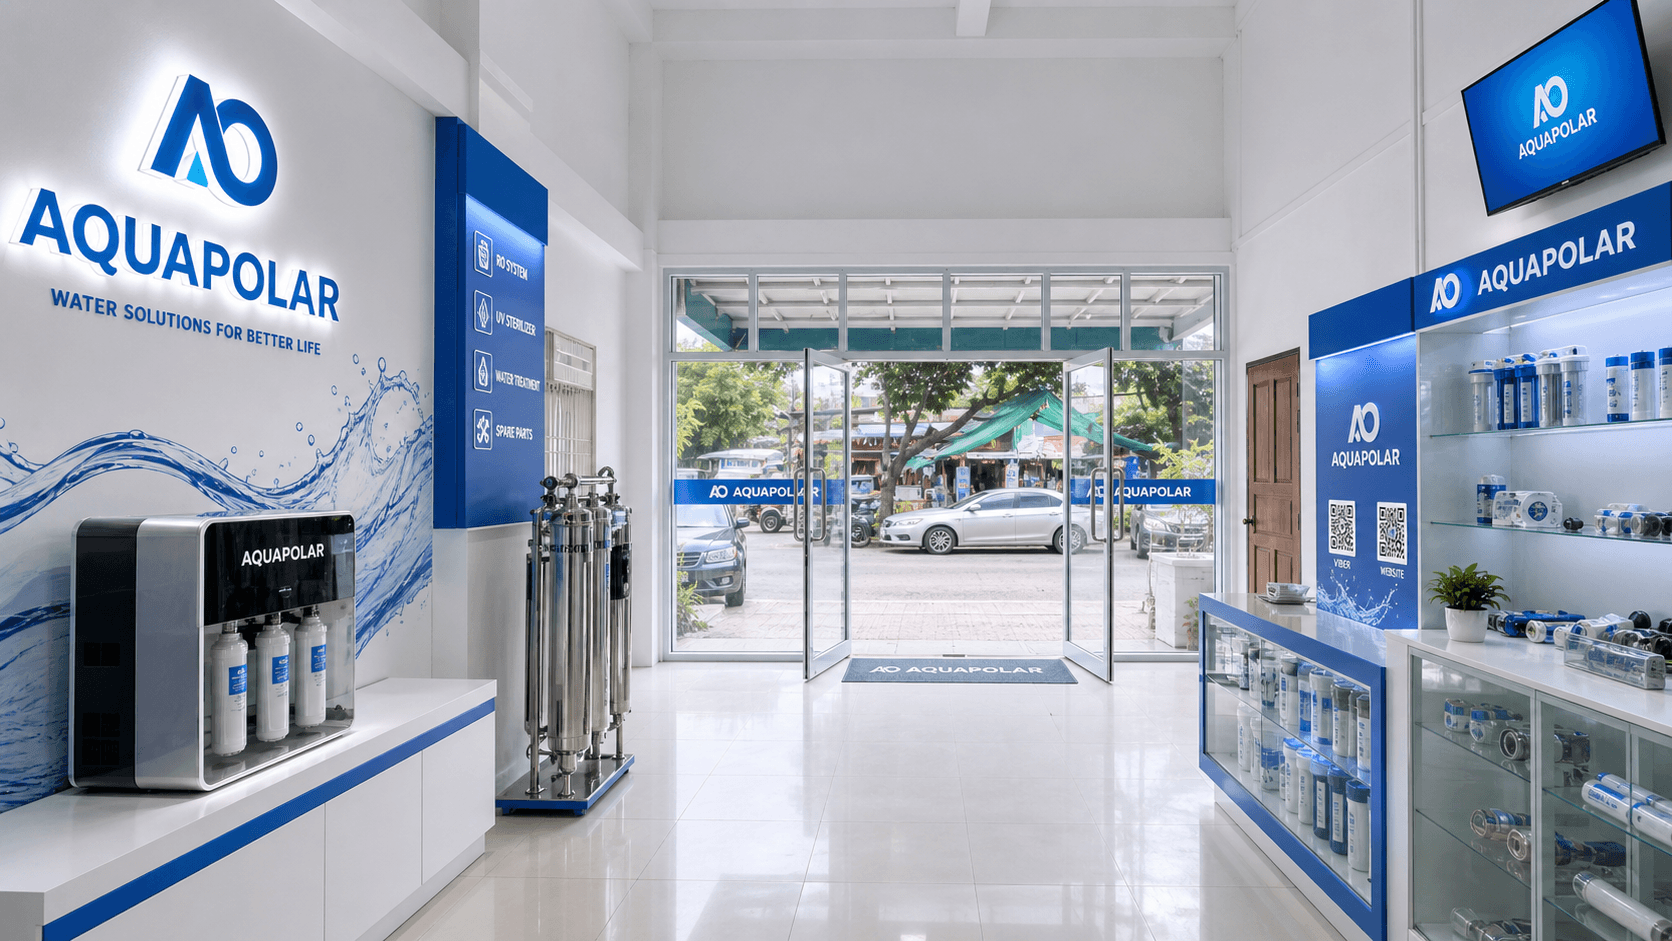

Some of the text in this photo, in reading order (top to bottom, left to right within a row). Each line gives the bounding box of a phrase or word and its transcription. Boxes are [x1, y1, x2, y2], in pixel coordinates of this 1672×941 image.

[1518, 107, 1598, 160] AQUAPOLAR
[17, 187, 340, 322] AQUAPOLAR
[1477, 220, 1637, 296] AQUAPOLAR
[51, 288, 321, 356] WATER SOLUTIONS FOR BETTER LIFE
[495, 424, 533, 441] SPARE PARTS
[1331, 448, 1401, 469] AQUAPOLAR
[241, 543, 325, 567] AQUAPOLAR
[905, 665, 1043, 675] AQUAPOLAR
